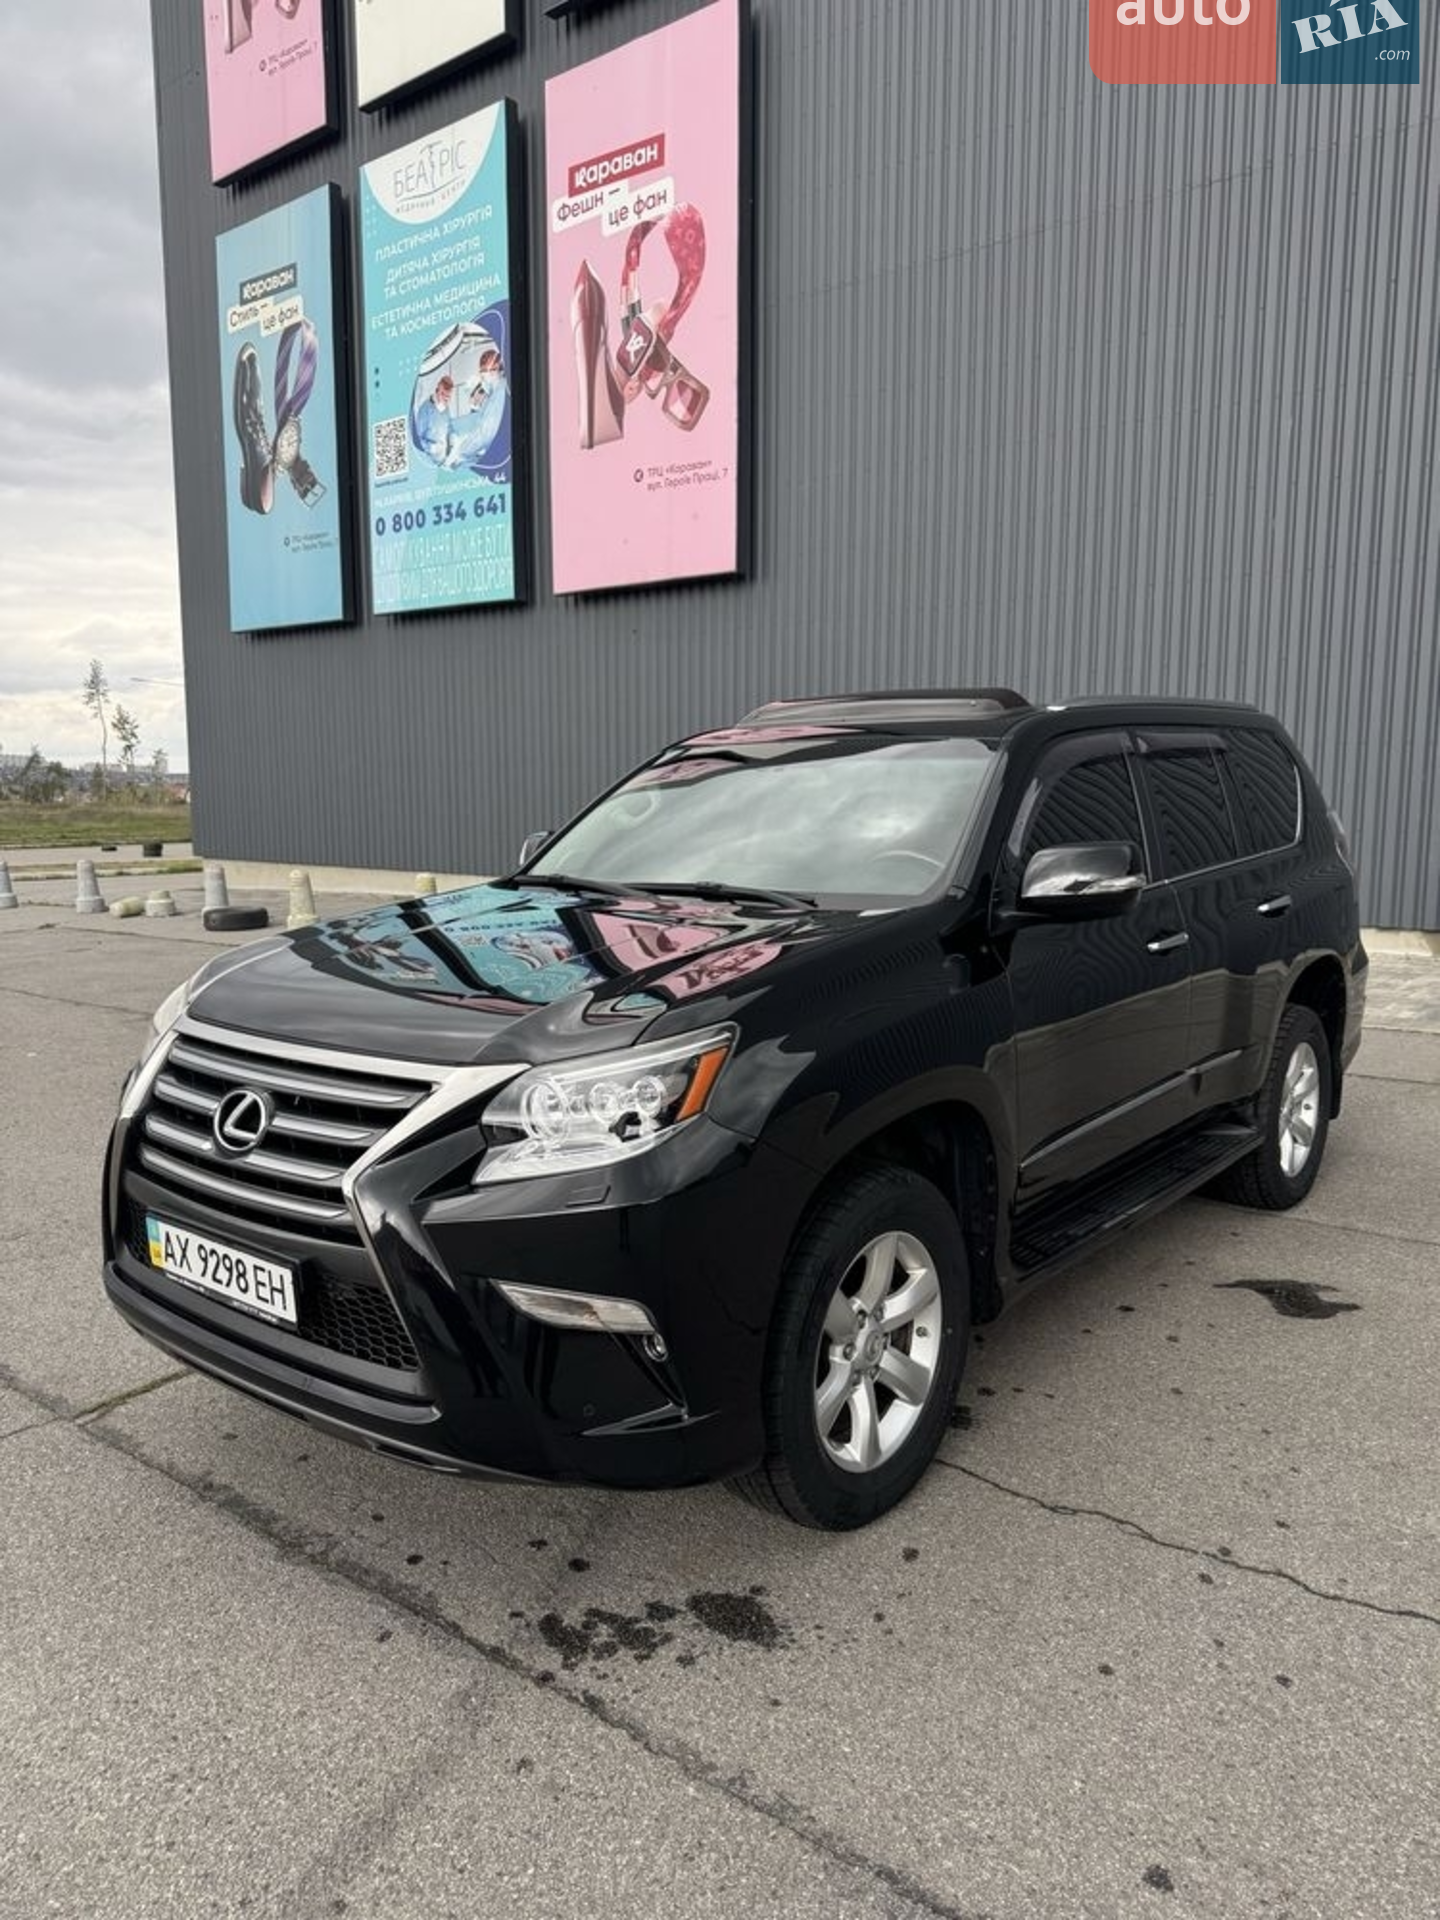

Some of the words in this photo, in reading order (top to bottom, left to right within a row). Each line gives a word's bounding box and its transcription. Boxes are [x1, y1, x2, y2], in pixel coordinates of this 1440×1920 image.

[557, 191, 604, 221] Фешн
[608, 205, 629, 226] це
[633, 189, 667, 219] фан
[376, 226, 440, 261] ПЛАСТИЧНА
[443, 204, 492, 235] ХІРУРГІЯ
[384, 286, 397, 299] ТА
[399, 252, 485, 295] СТОМАТОЛОГІЯ
[386, 257, 429, 284] ДИТЯЧА
[431, 235, 480, 266] ХІРУРГІЯ
[230, 306, 259, 328] Стиль
[262, 314, 276, 331] це
[278, 304, 298, 326] фан
[372, 297, 431, 329] ЕСТЕТИЧНА
[434, 272, 501, 304] МЕДИЦИНА
[385, 325, 398, 338] ТА
[401, 295, 485, 335] КОСМЕТОЛОГІЯ
[375, 517, 386, 536] 0
[392, 508, 426, 533] 800
[432, 501, 467, 526] 334
[473, 492, 507, 518] 641
[164, 1231, 192, 1273] AX
[197, 1243, 249, 1295] 9298
[253, 1264, 287, 1311] EH
